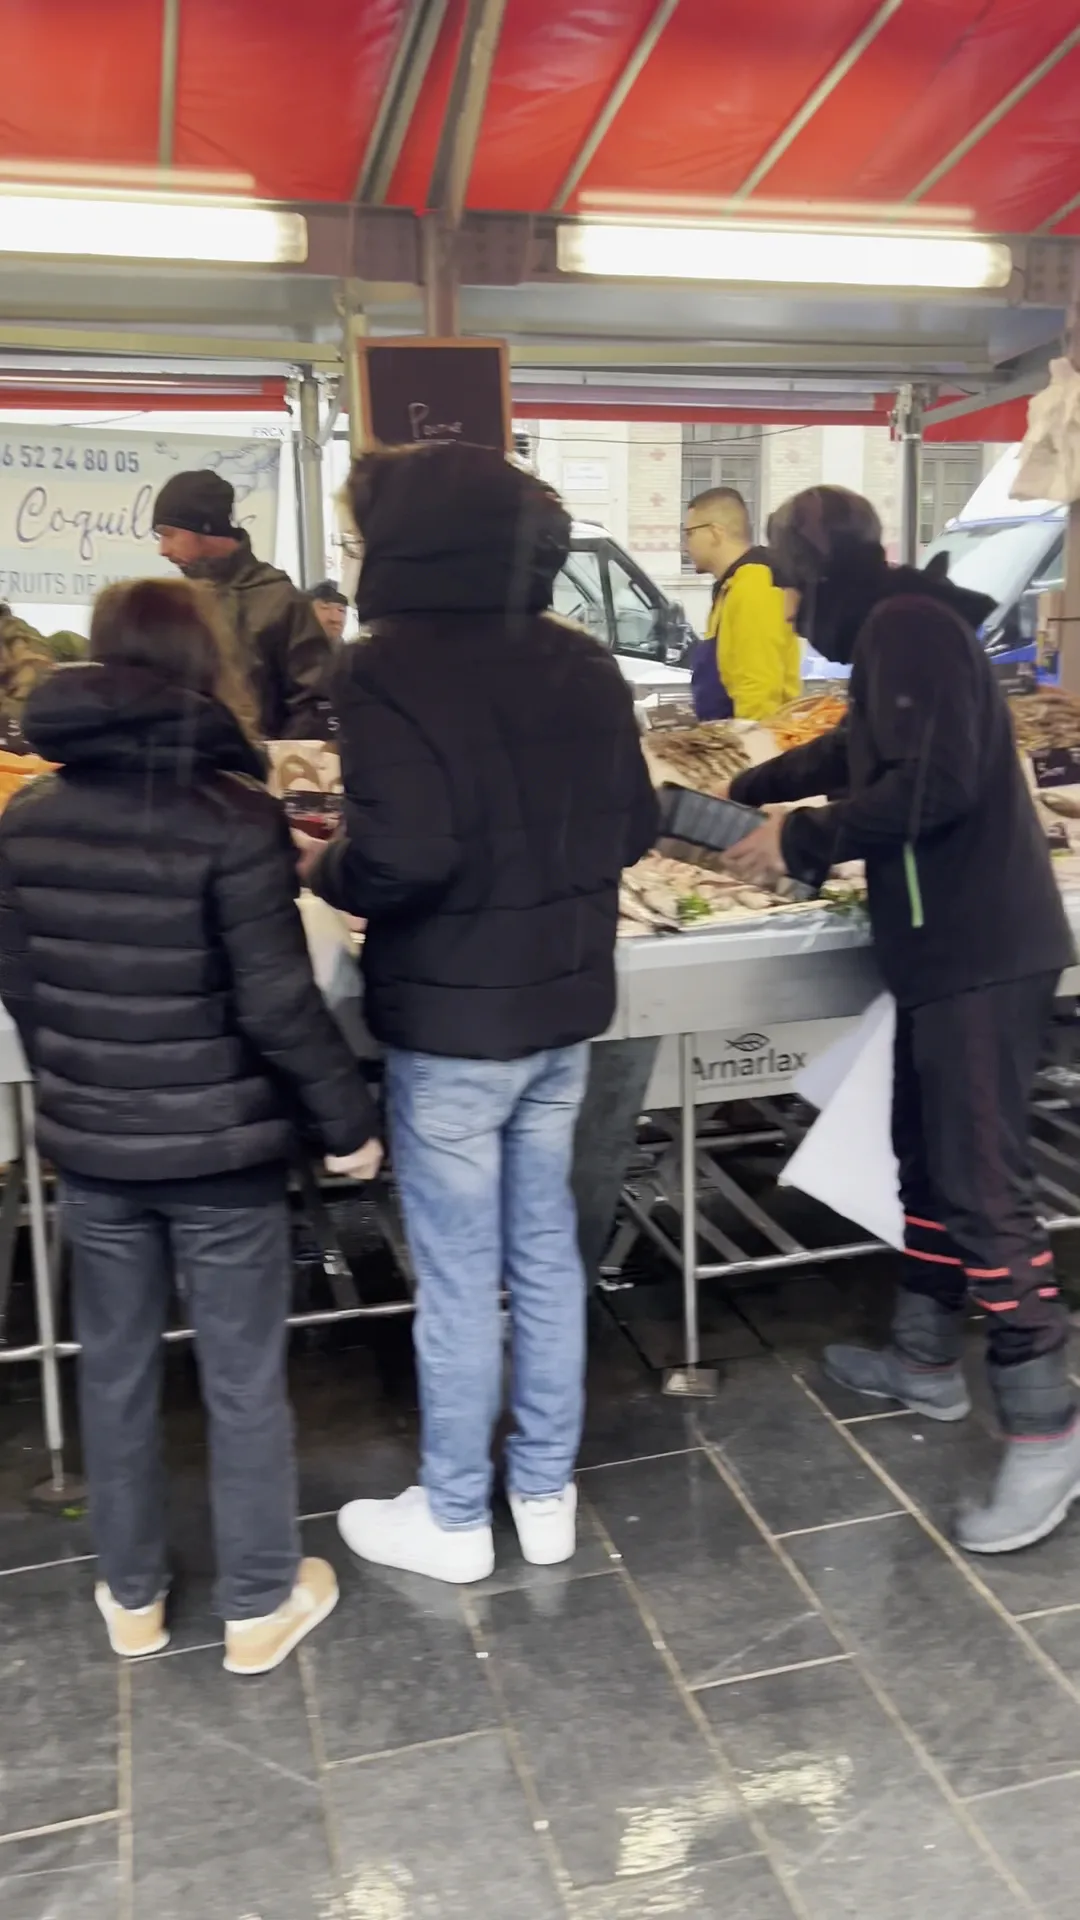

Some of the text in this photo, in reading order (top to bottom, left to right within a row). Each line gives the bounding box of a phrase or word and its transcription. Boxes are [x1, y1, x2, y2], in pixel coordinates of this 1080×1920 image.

[20, 445, 45, 469] 52
[52, 446, 77, 471] 24
[84, 448, 108, 472] 80
[115, 450, 139, 474] 05
[16, 485, 158, 561] Coquil
